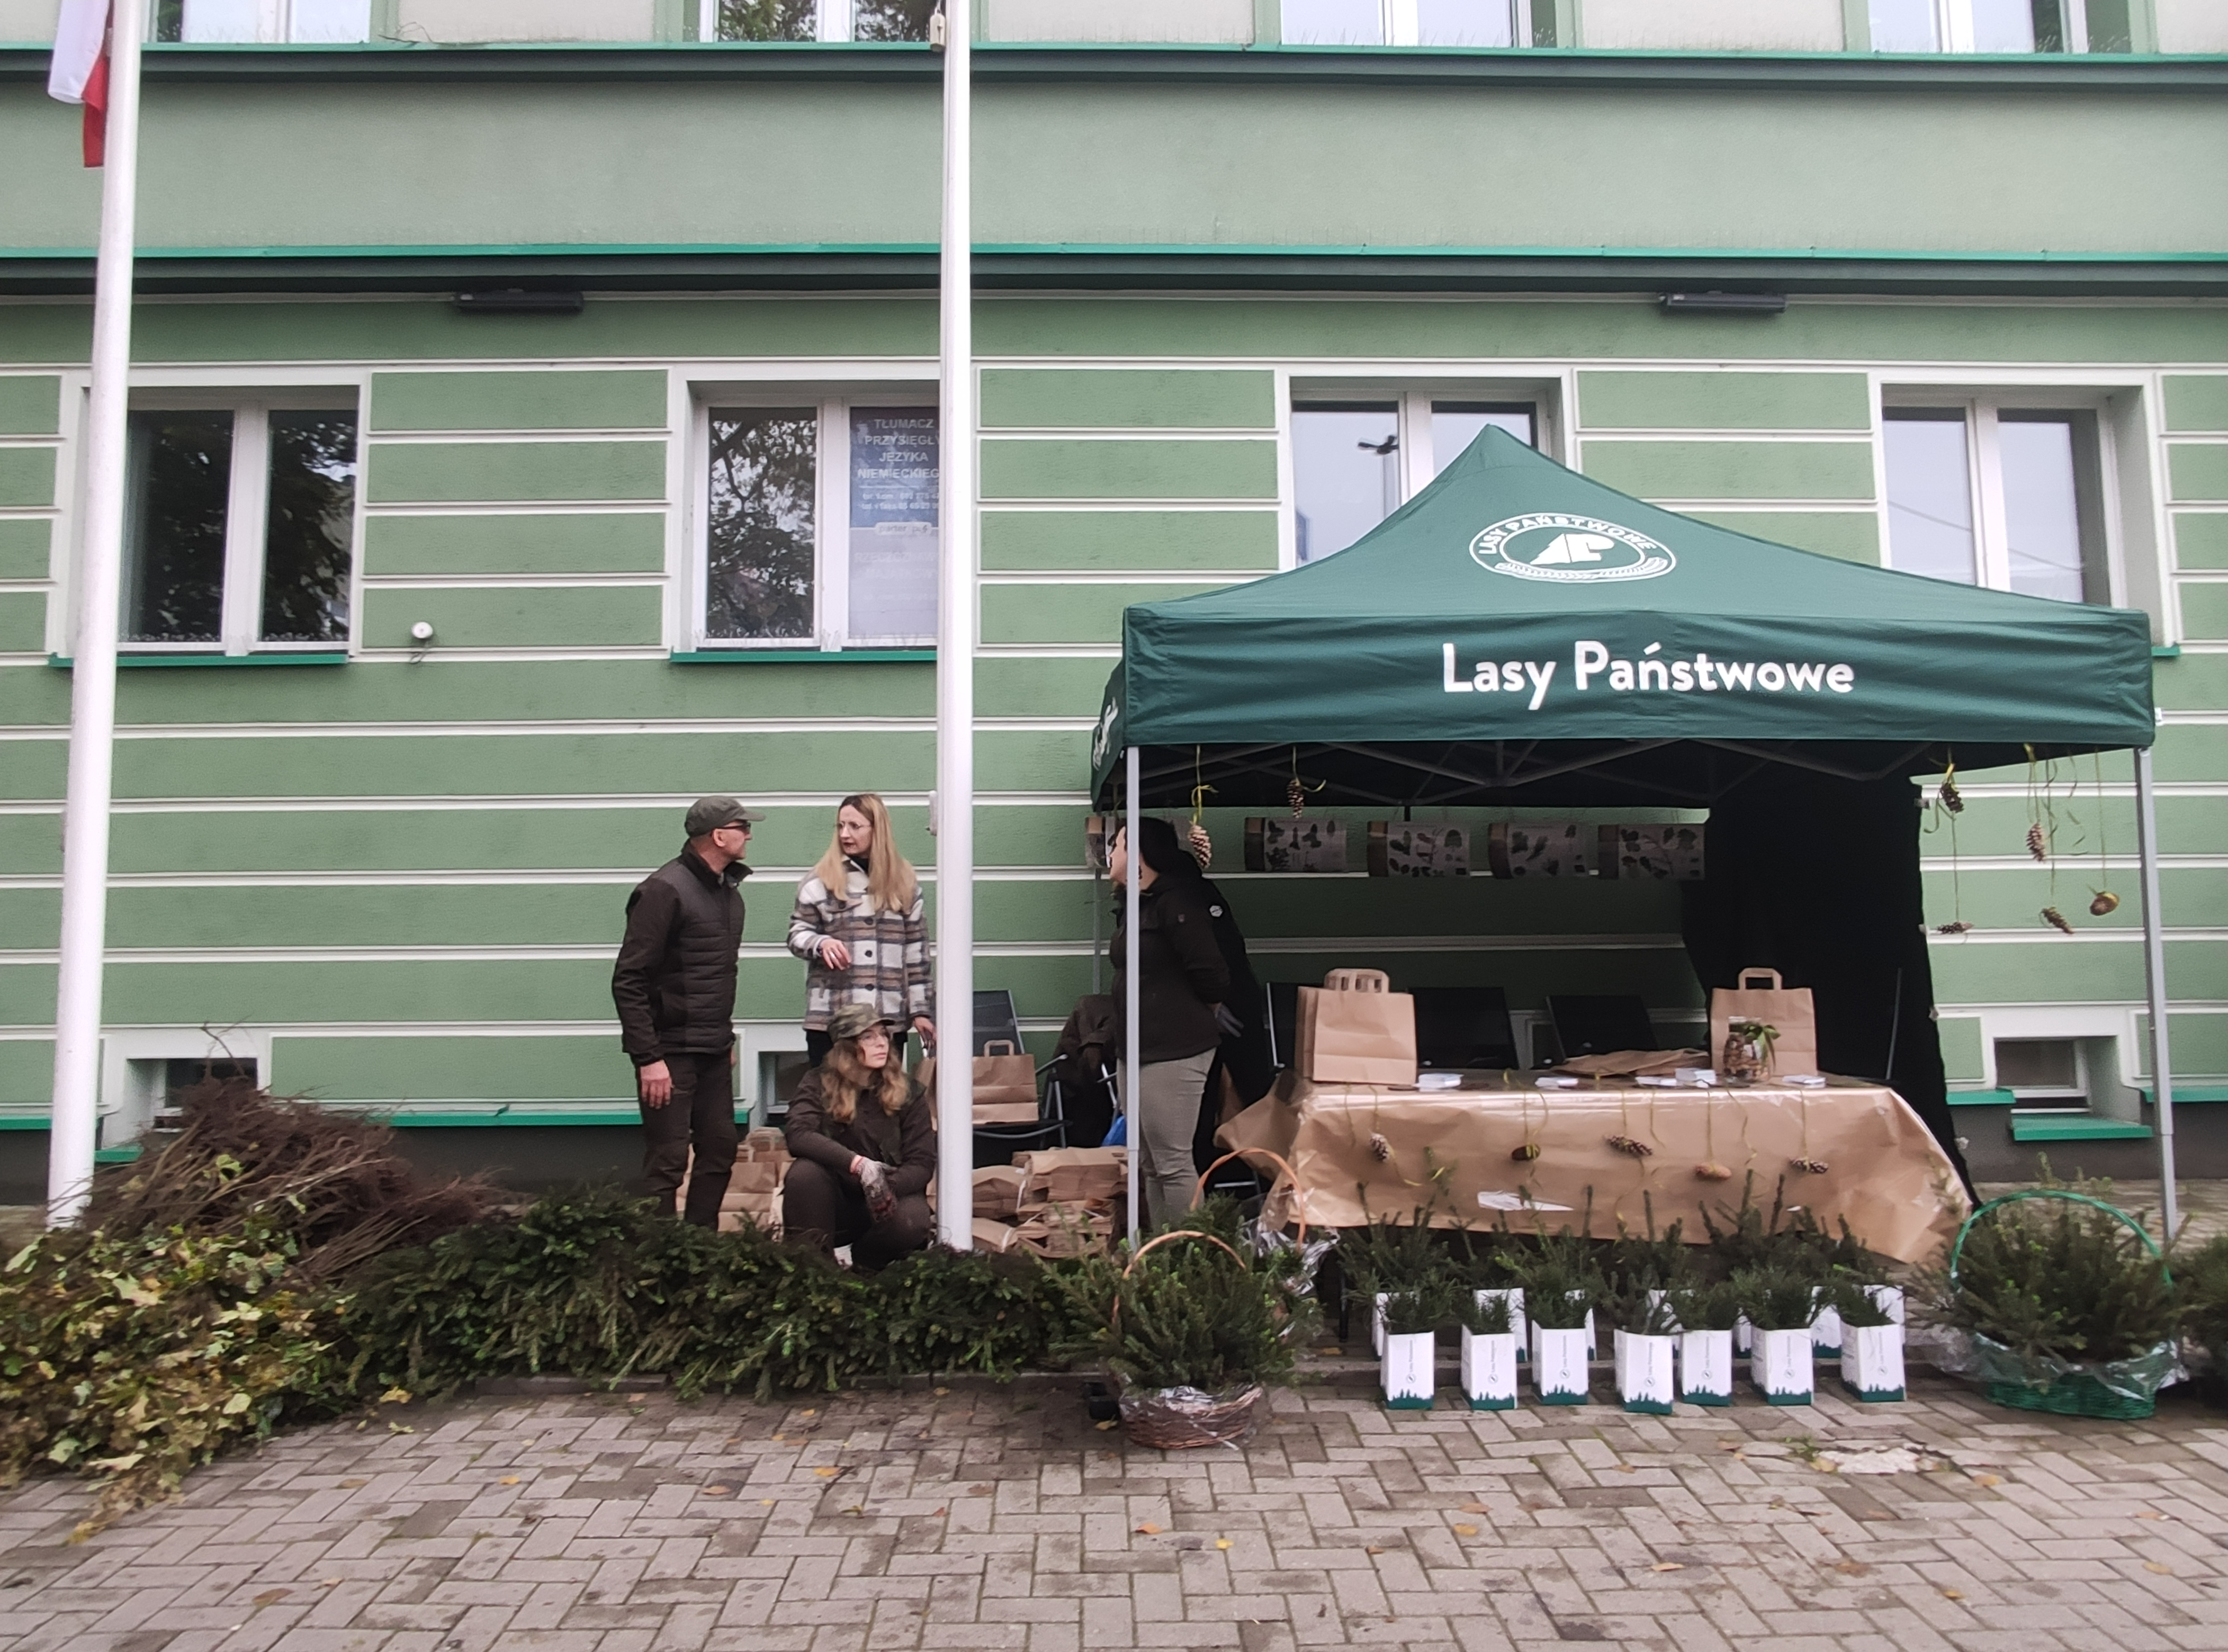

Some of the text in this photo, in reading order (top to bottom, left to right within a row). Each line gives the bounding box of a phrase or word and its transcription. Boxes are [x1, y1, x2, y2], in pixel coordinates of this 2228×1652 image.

[874, 418, 935, 429] TŁUMACZ
[858, 468, 939, 479] NIEMIECKIEG
[1443, 640, 1855, 710] Lasy Państwowe
